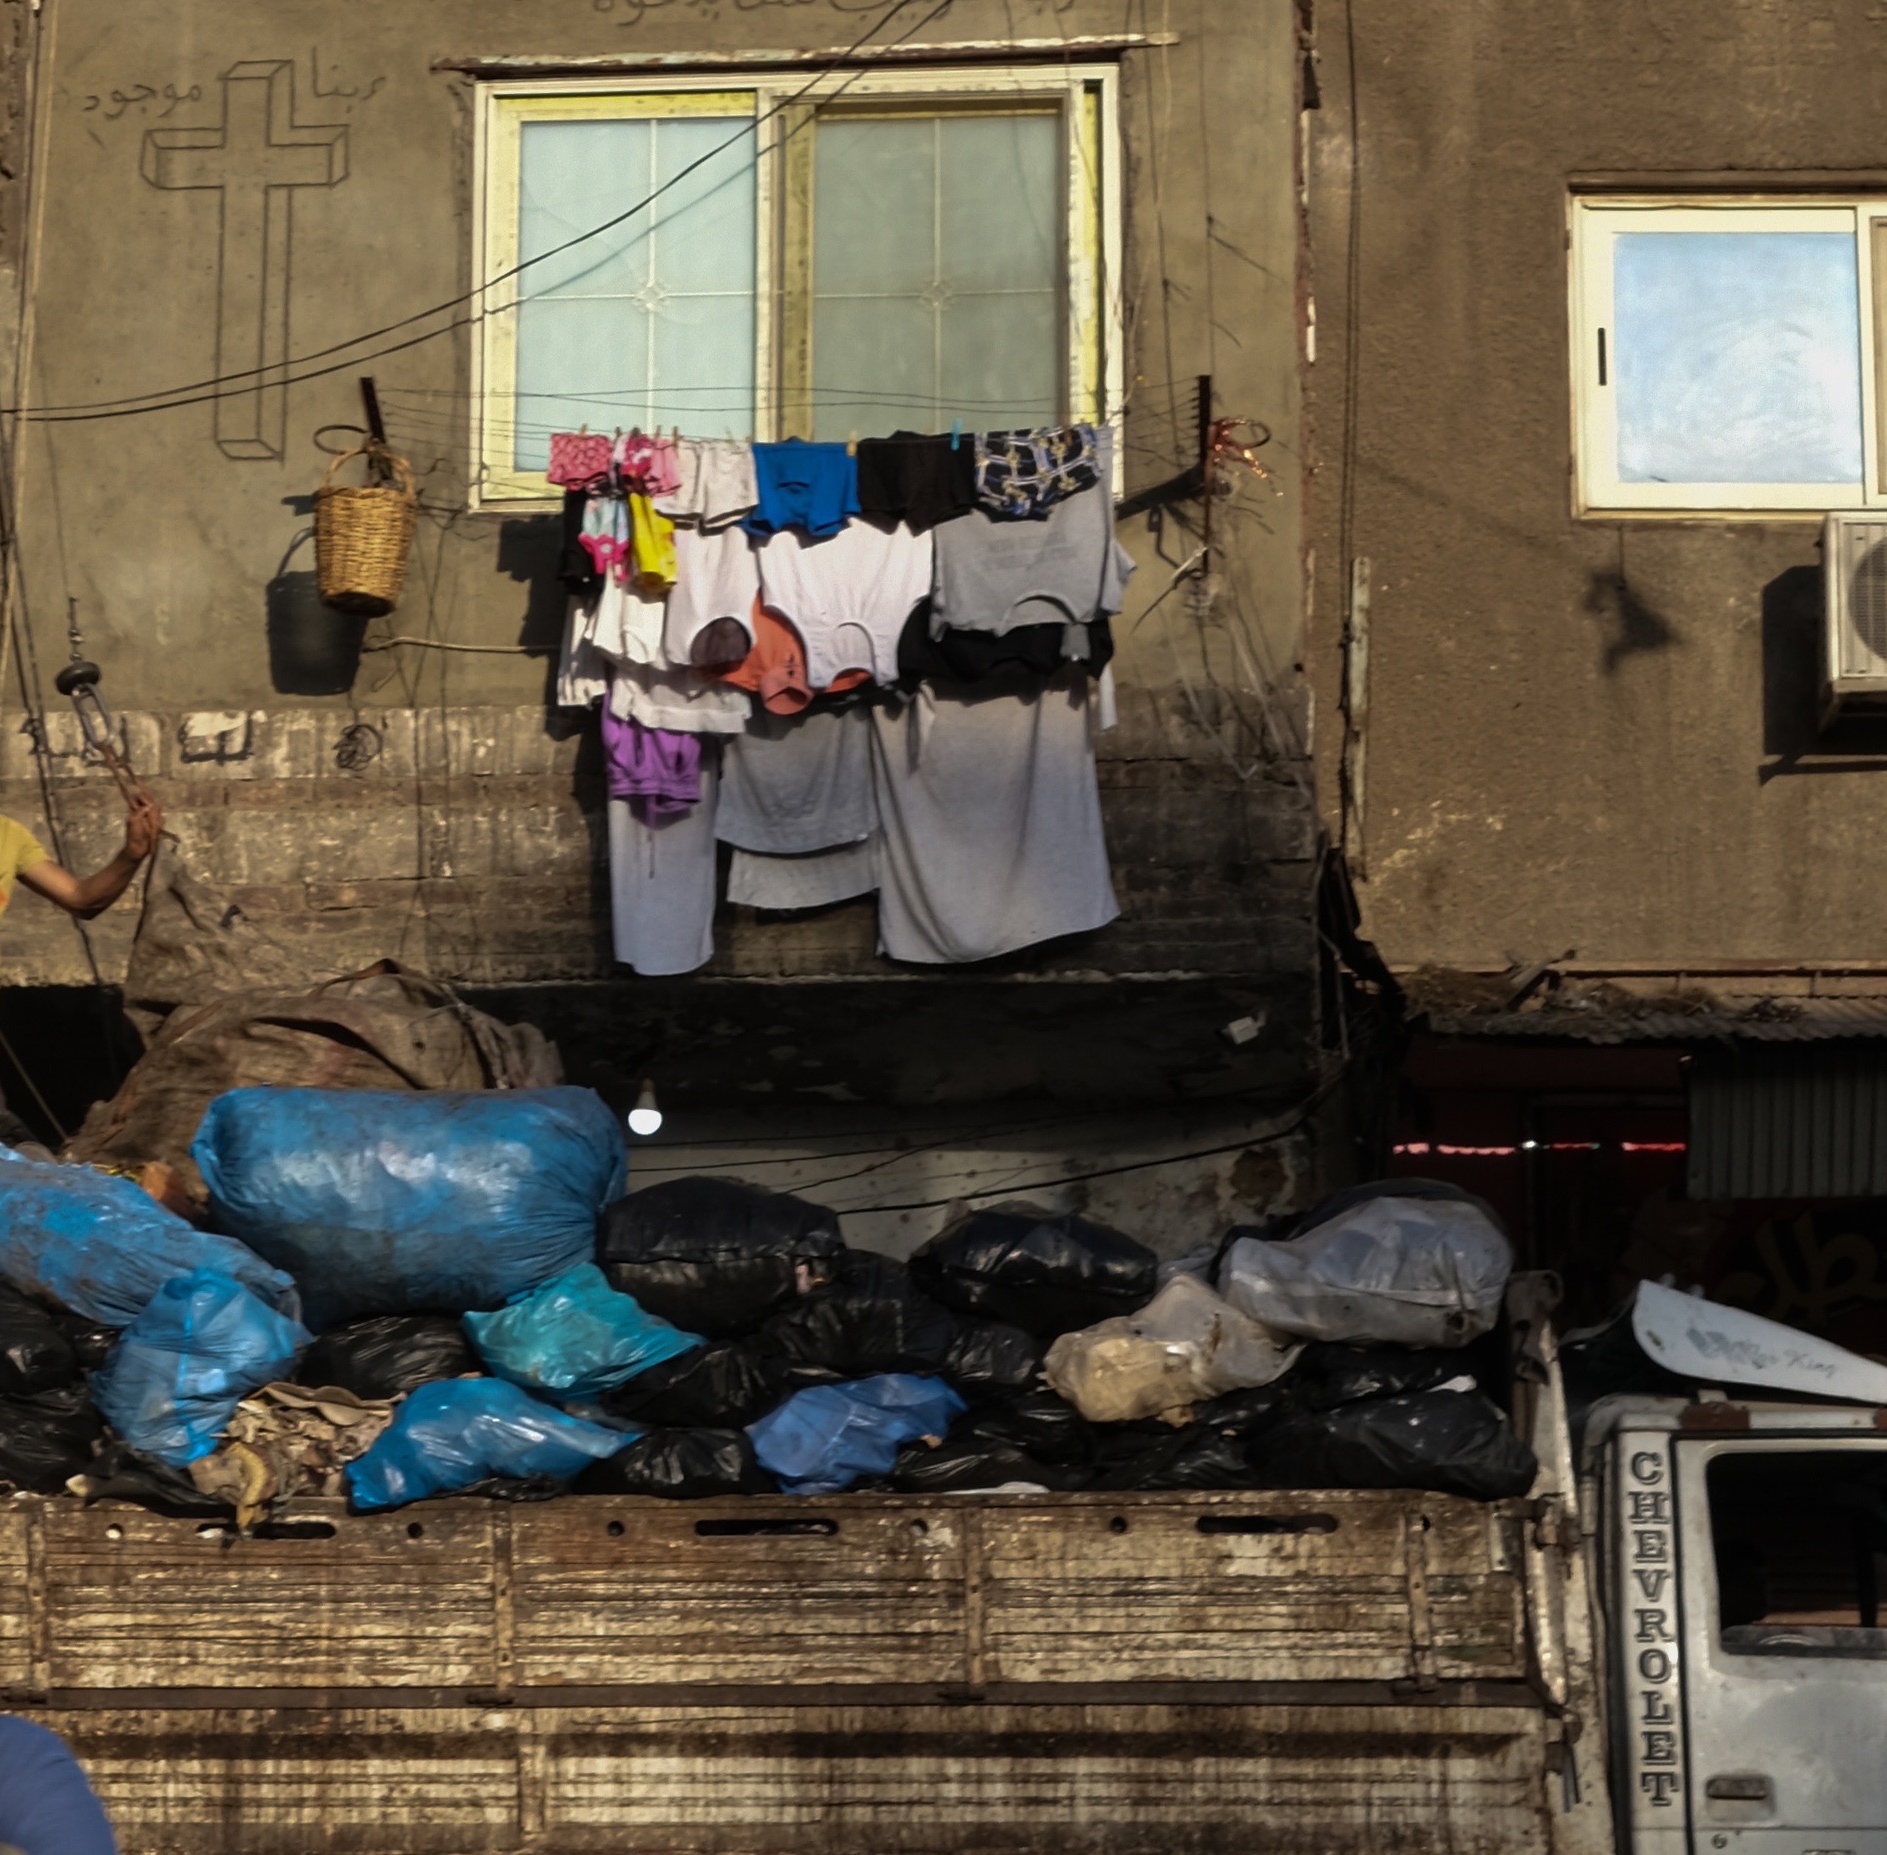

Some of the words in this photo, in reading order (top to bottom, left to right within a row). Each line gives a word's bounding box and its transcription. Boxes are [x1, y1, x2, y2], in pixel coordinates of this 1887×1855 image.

[82, 83, 202, 119] موجود
[312, 46, 386, 113] ربنا
[1628, 1451, 1679, 1808] CHEVROLET
